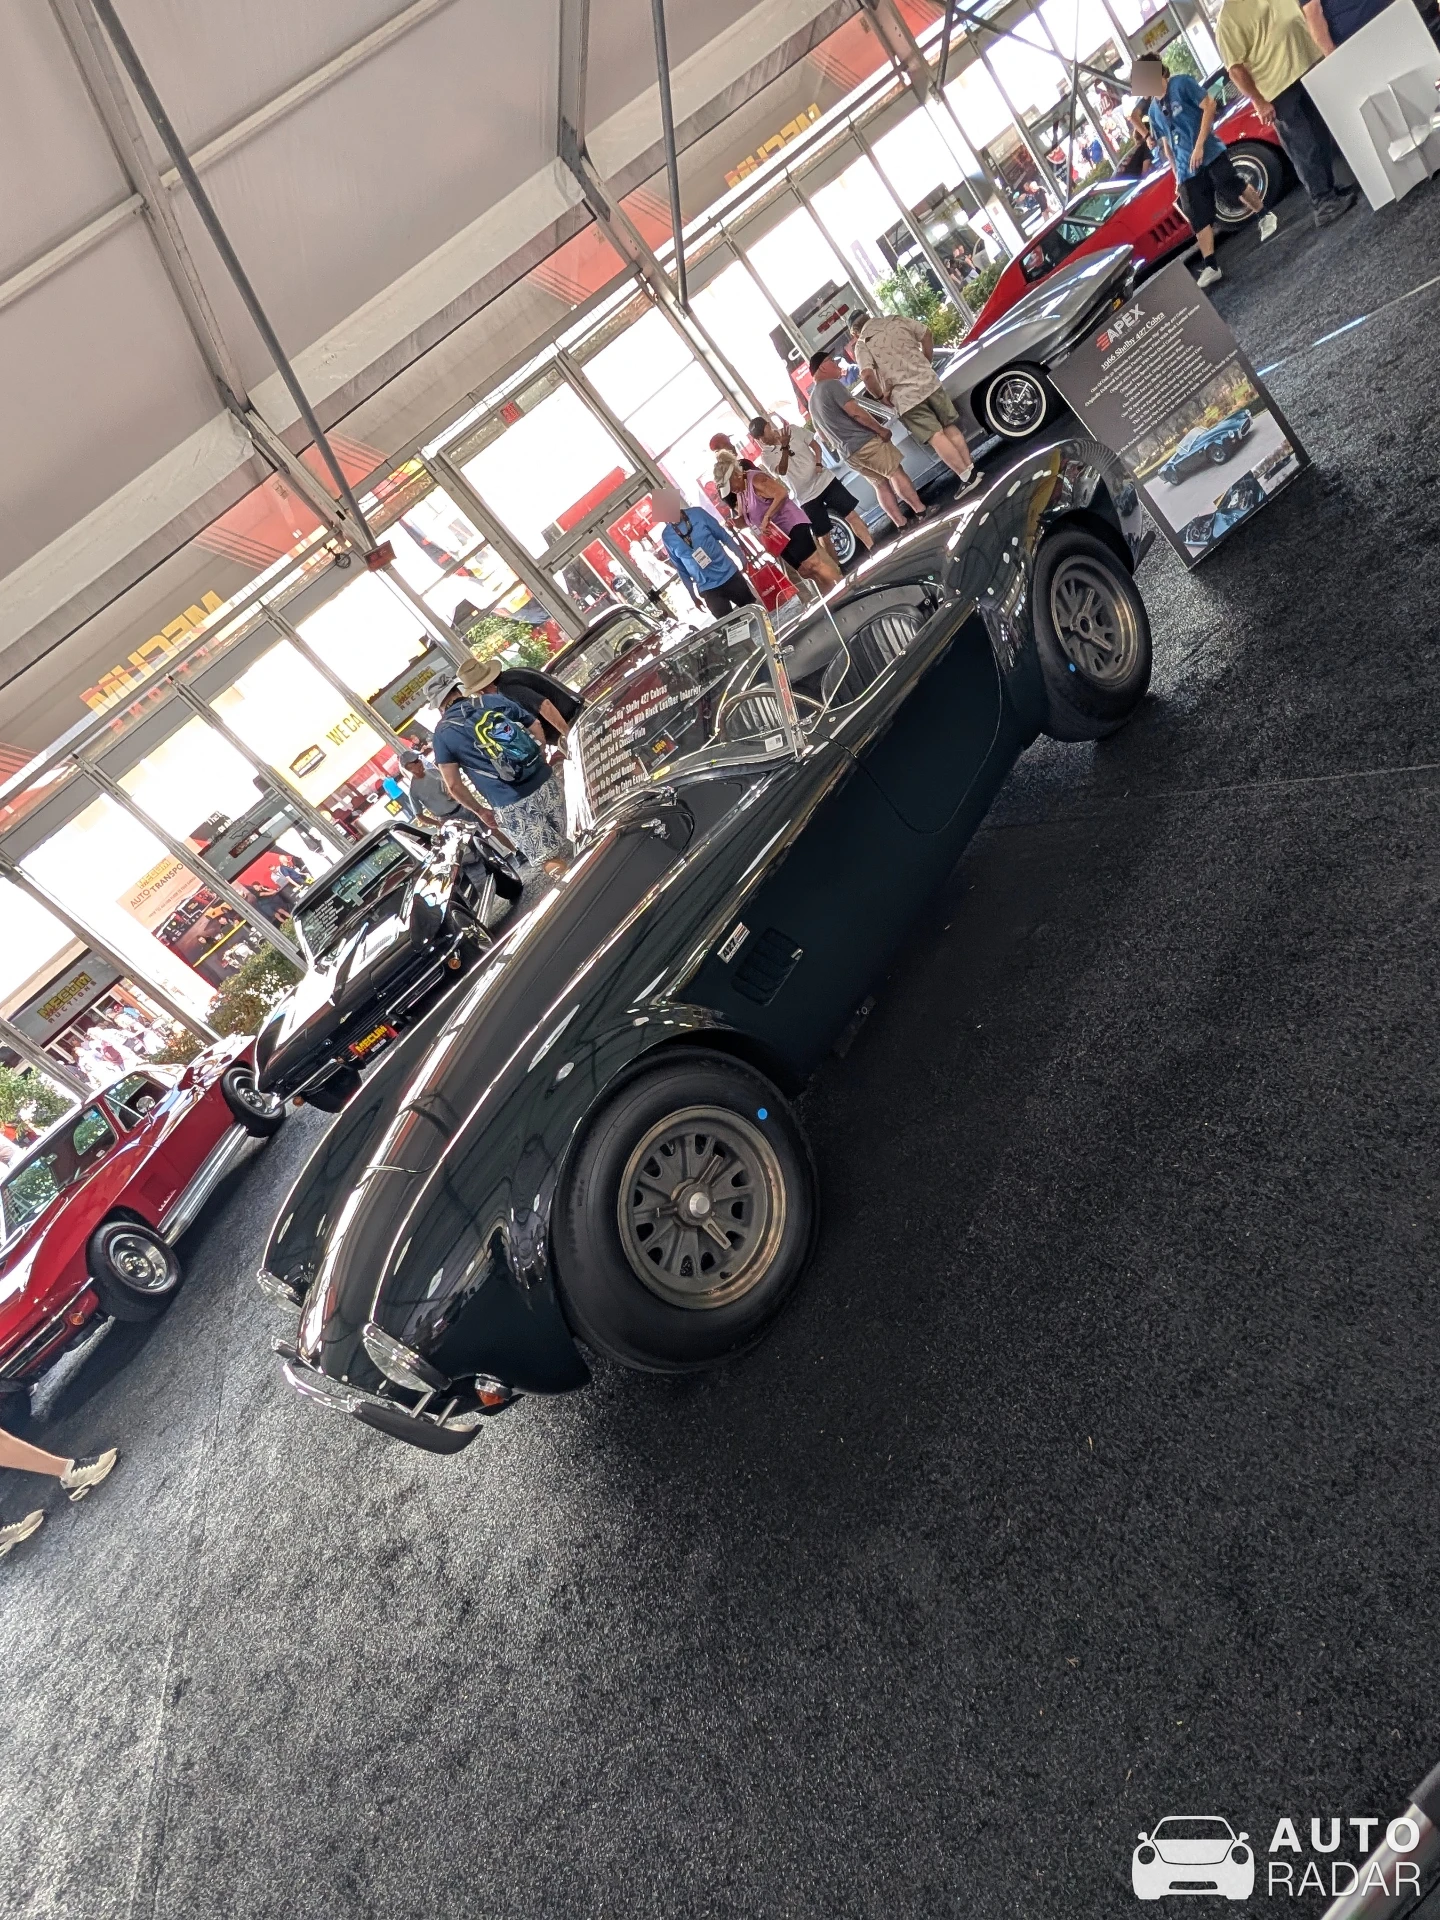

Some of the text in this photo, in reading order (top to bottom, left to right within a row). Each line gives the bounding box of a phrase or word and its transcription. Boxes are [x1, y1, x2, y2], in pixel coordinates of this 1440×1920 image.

[1100, 353, 1116, 369] 1966
[1114, 336, 1136, 357] Shelby
[1135, 326, 1148, 340] 427
[1144, 310, 1165, 329] Cobra
[1105, 303, 1145, 343] APEX
[391, 665, 436, 706] MECUM
[399, 690, 422, 710] AUCT
[639, 692, 649, 704] 427
[649, 684, 667, 699] Cobras
[325, 712, 364, 746] WE CA
[644, 703, 658, 718] Black
[129, 861, 184, 907] AUTO TRANSPO
[722, 937, 736, 957] 427
[36, 971, 92, 1019] MECUM
[48, 980, 97, 1024] AUCTIONS
[354, 1024, 387, 1052] MECUM
